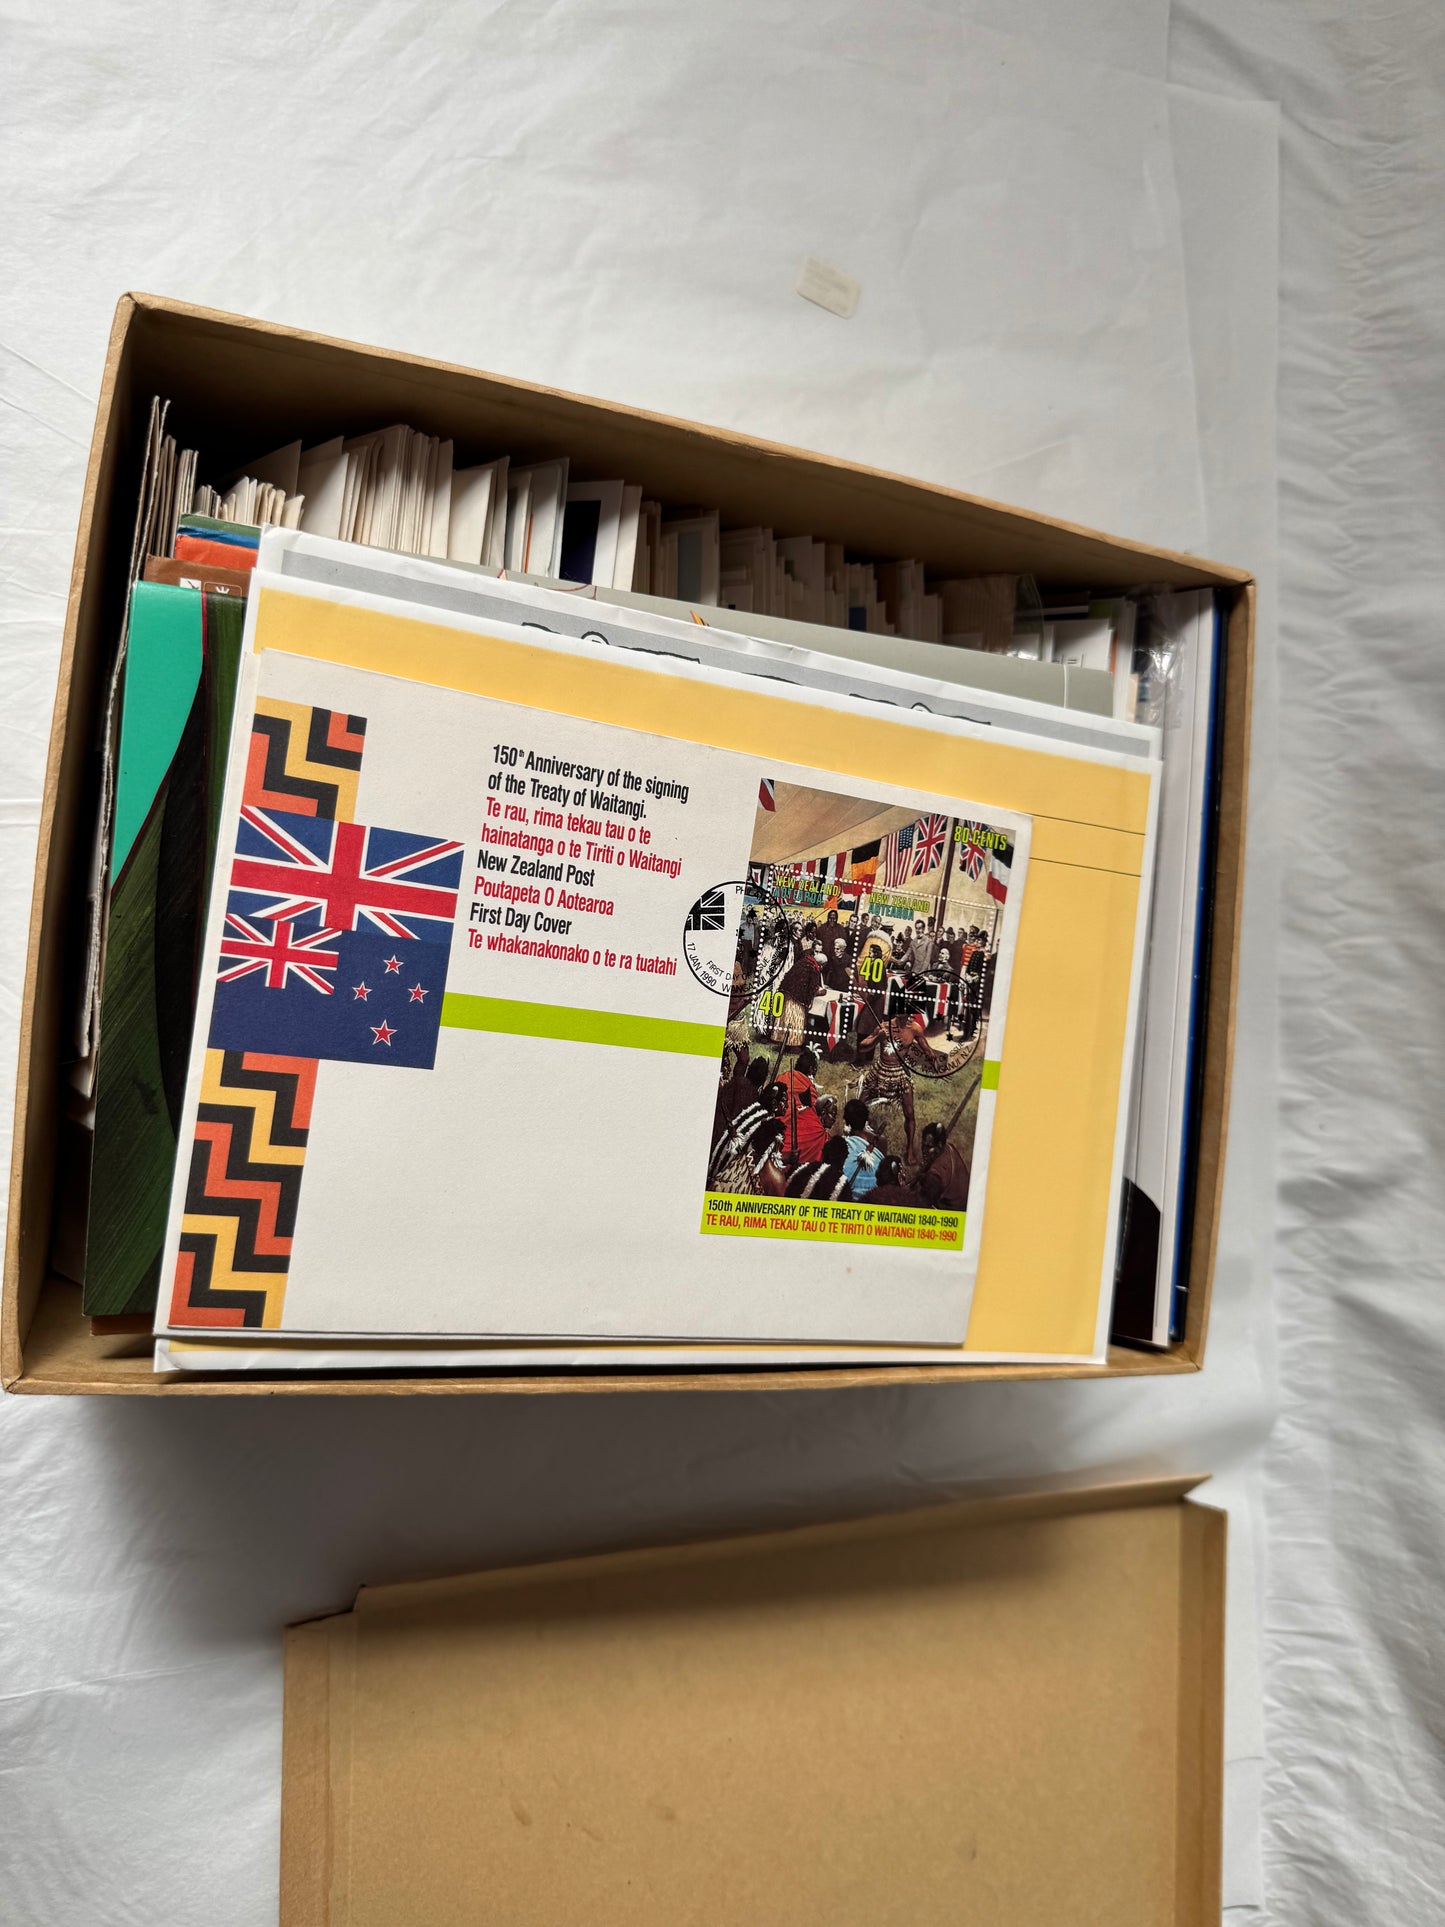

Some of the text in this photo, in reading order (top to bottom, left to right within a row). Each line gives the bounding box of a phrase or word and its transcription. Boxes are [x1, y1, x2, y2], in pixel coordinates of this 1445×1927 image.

[525, 751, 604, 787] Anniversary
[607, 769, 621, 787] of
[622, 771, 642, 791] the
[645, 775, 689, 804] signing
[488, 772, 647, 822] of the Treaty of Waitangi.
[486, 797, 651, 845] Te rau, rima tekau tau o te
[481, 823, 682, 879] hainatanga o te Tiriti o Waitangi
[953, 825, 1007, 851] 80 CENTS
[477, 850, 595, 888] New Zealand Post
[775, 875, 797, 889] NEW
[474, 876, 615, 916] Poutapeta O Aotearoa
[869, 892, 930, 914] NEW ZEALAND
[470, 902, 573, 935] First Day Cover
[868, 904, 915, 922] AOTEAROA
[468, 928, 677, 976] Te whakanakonako o te ra tuatahi
[688, 943, 696, 951] 17
[689, 954, 702, 971] JAN
[706, 960, 724, 977] FIRST
[860, 958, 883, 983] 40
[700, 970, 717, 987] 1990
[759, 992, 785, 1018] 40
[708, 1199, 958, 1228] 150th ANNIVERSARY OF THE TREATY OF WAITANGI 1840-1990
[706, 1214, 957, 1242] TE RAU, RIMA TEKAU TAU O TE TIRITI O WAITANGI 1840-1990
